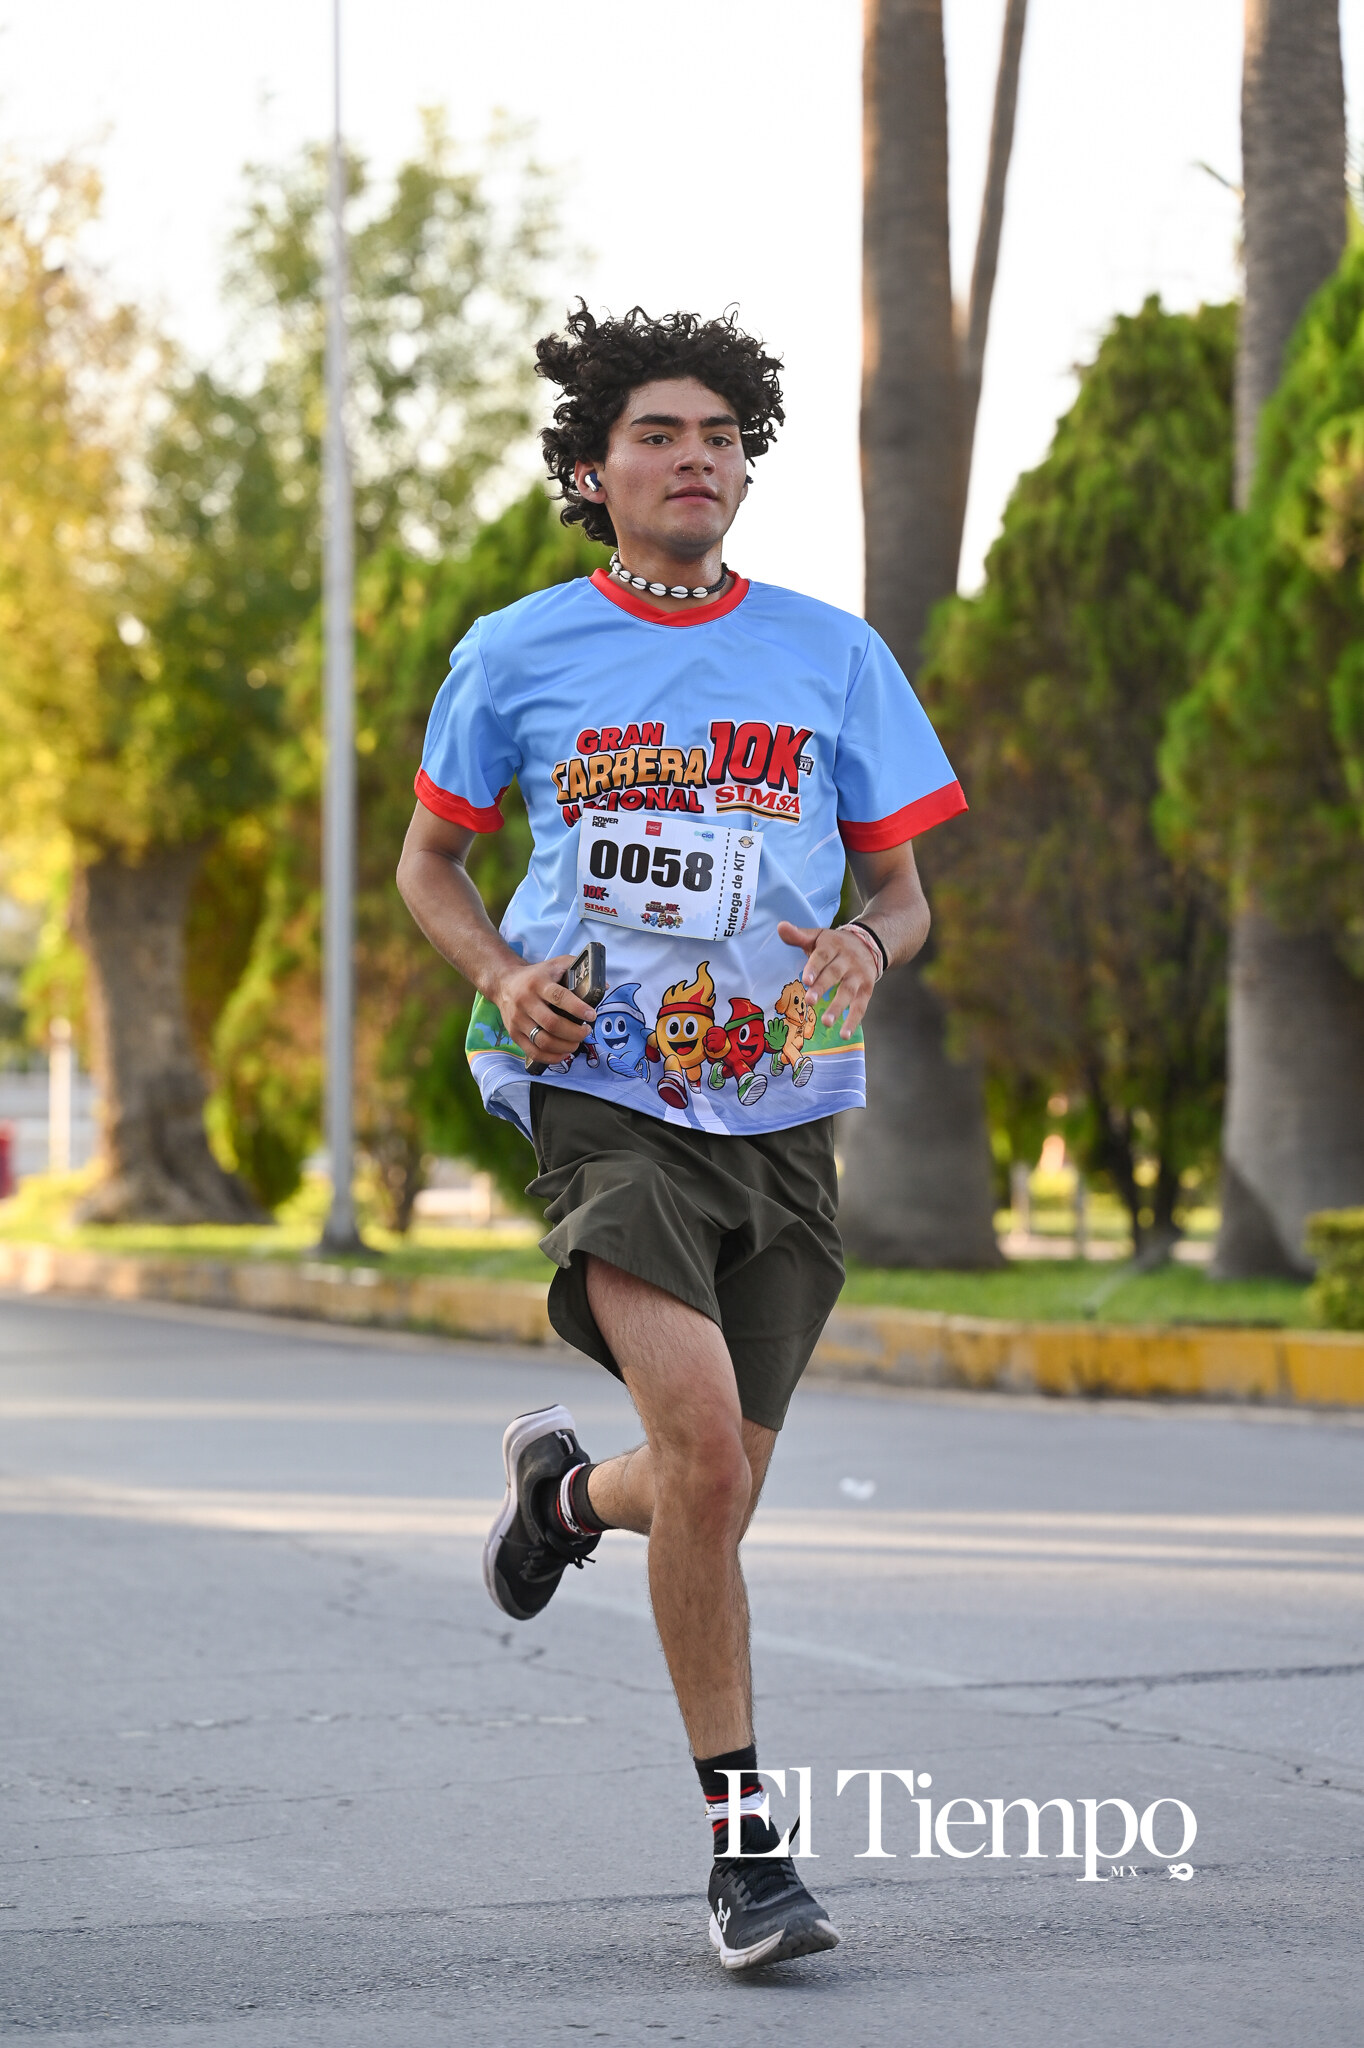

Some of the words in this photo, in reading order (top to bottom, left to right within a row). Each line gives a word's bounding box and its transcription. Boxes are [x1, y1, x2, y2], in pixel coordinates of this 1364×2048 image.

[576, 721, 665, 755] GRAN
[708, 721, 814, 794] 10K
[551, 747, 708, 804] CARRERA
[715, 785, 801, 815] SIMSA
[593, 815, 619, 824] POWER
[589, 839, 714, 892] 0058
[733, 850, 745, 872] KIT
[583, 884, 607, 901] 10K
[731, 874, 743, 889] de
[584, 902, 618, 915] SIMSA
[724, 892, 743, 937] Entrega
